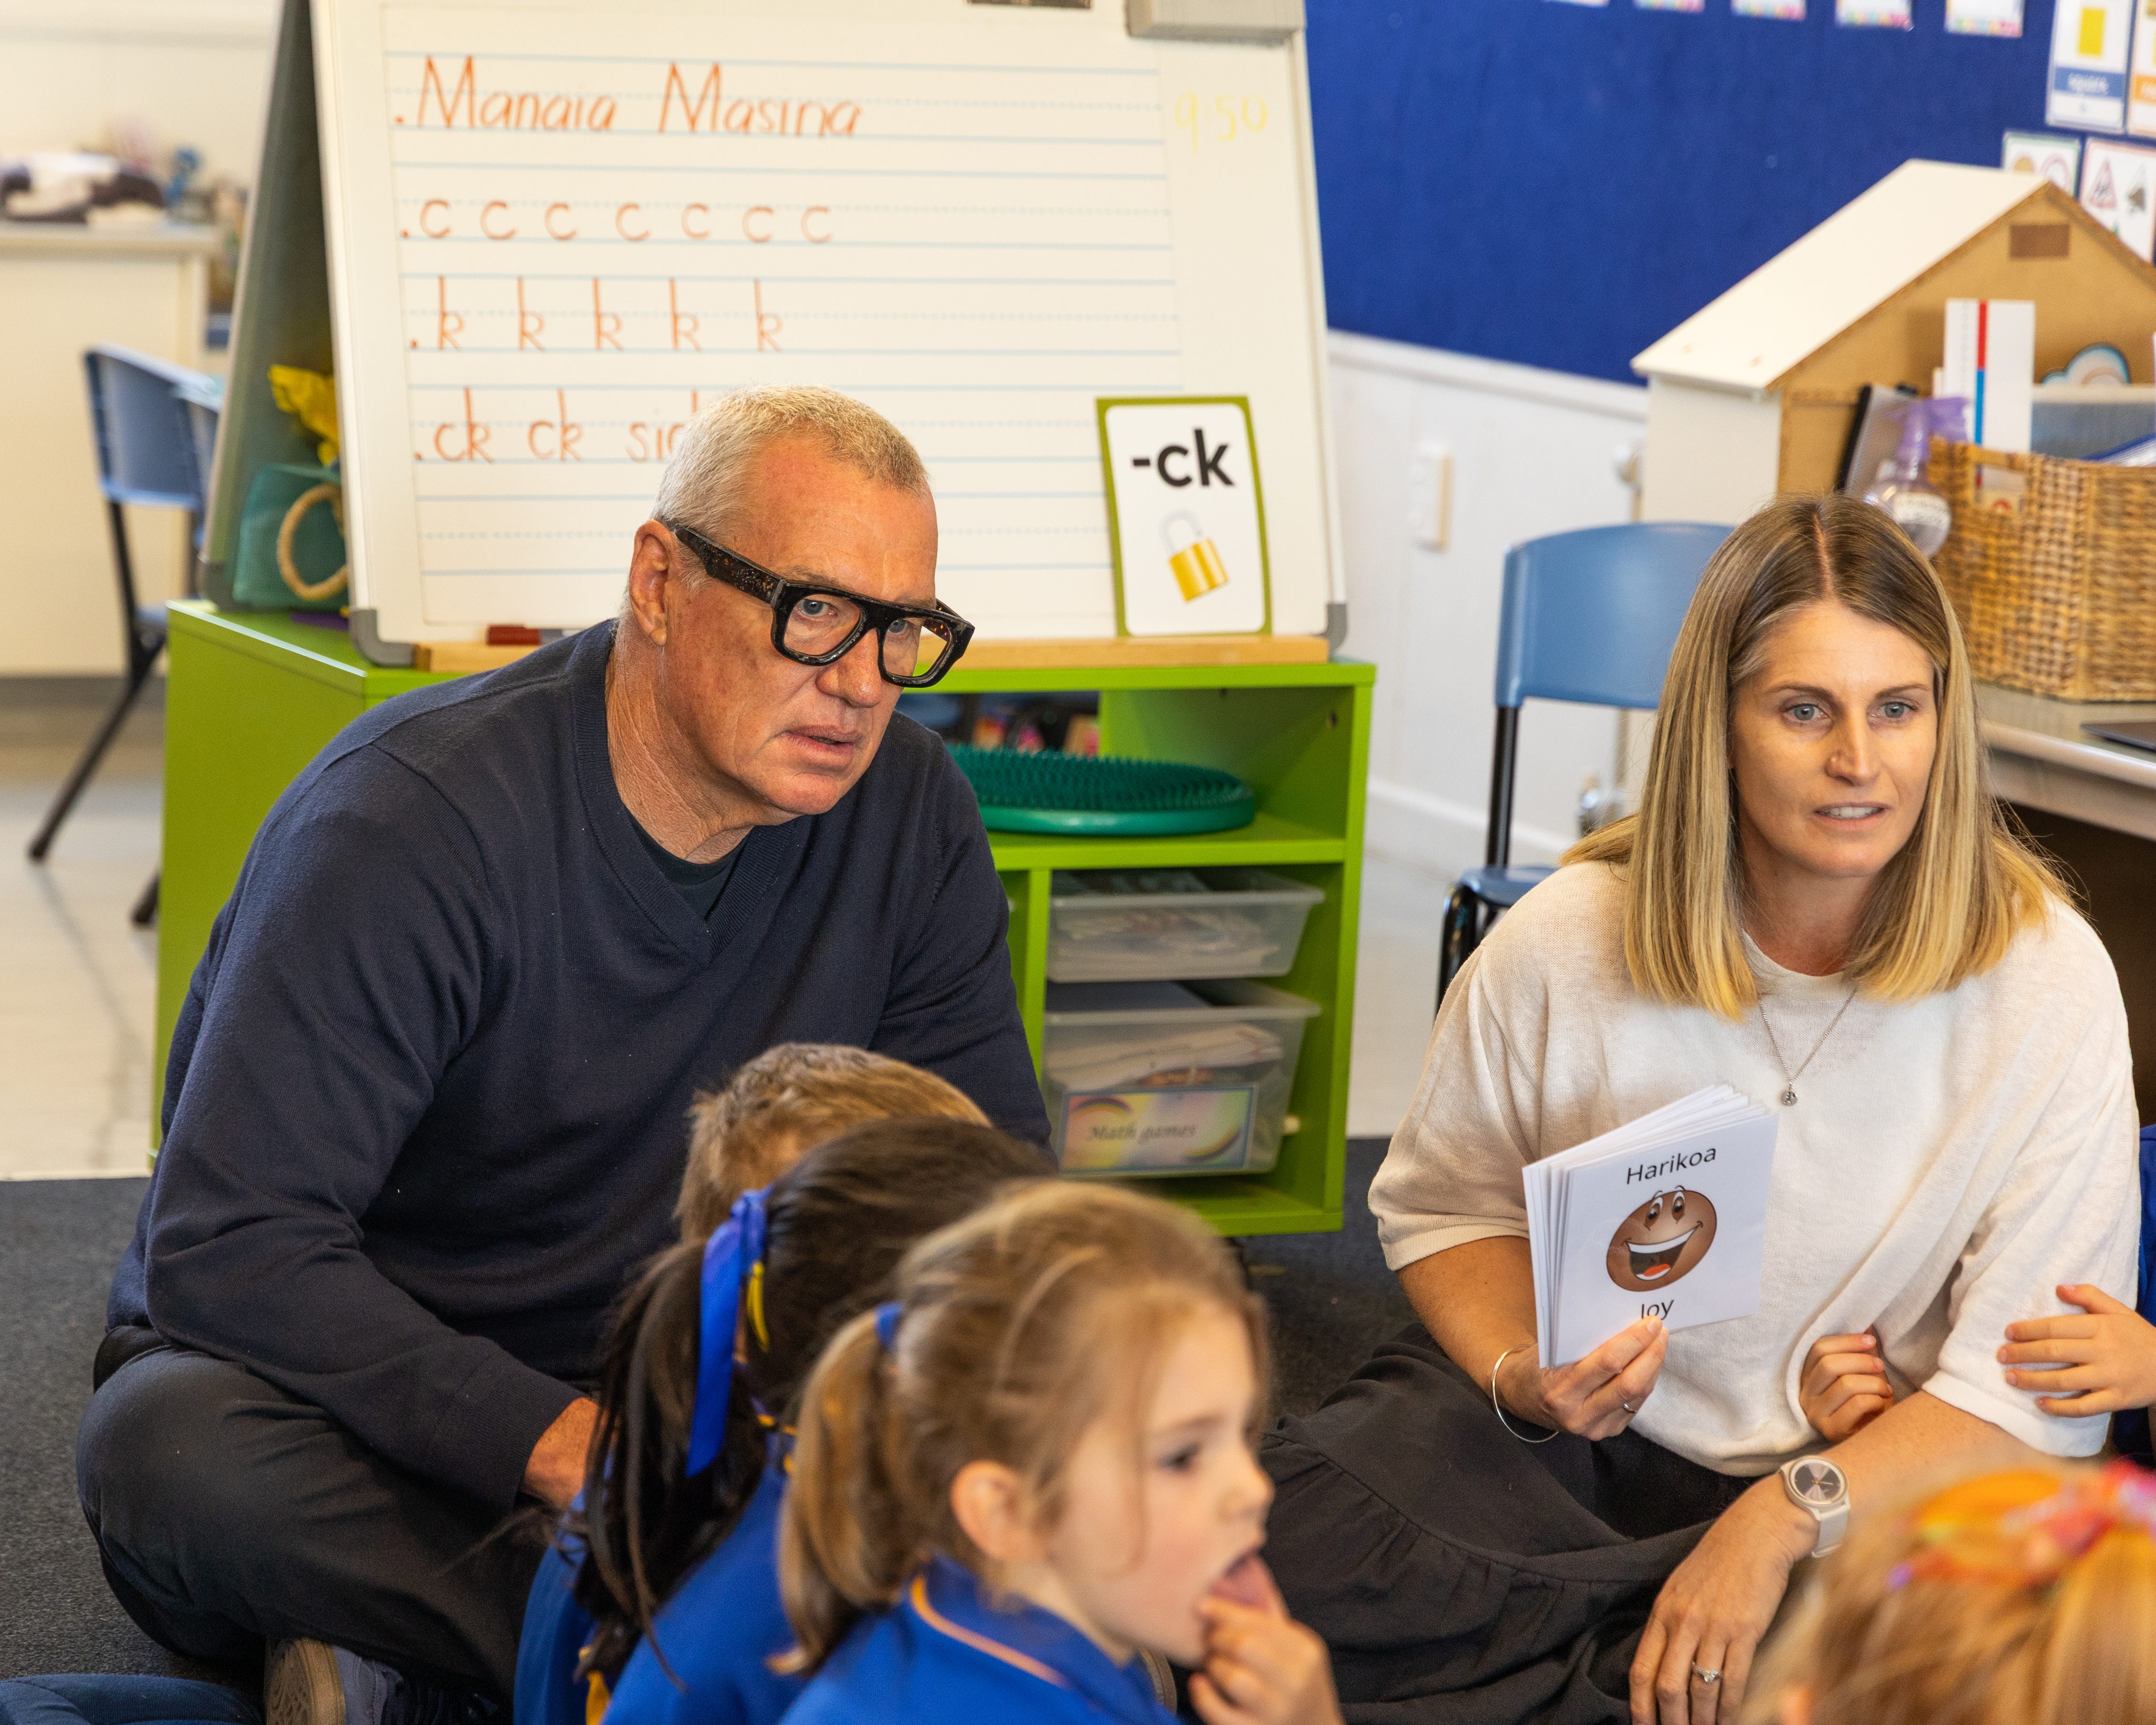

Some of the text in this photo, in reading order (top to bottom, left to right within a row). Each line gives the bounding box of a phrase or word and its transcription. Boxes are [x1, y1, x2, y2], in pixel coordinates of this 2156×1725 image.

[415, 55, 863, 137] Manaia Masina
[419, 198, 832, 243] c c c c c c c
[436, 275, 783, 351] k k k k k
[432, 387, 698, 463] ck ck sic
[1132, 427, 1236, 487] -ck
[1626, 1147, 1716, 1185] Harikoa
